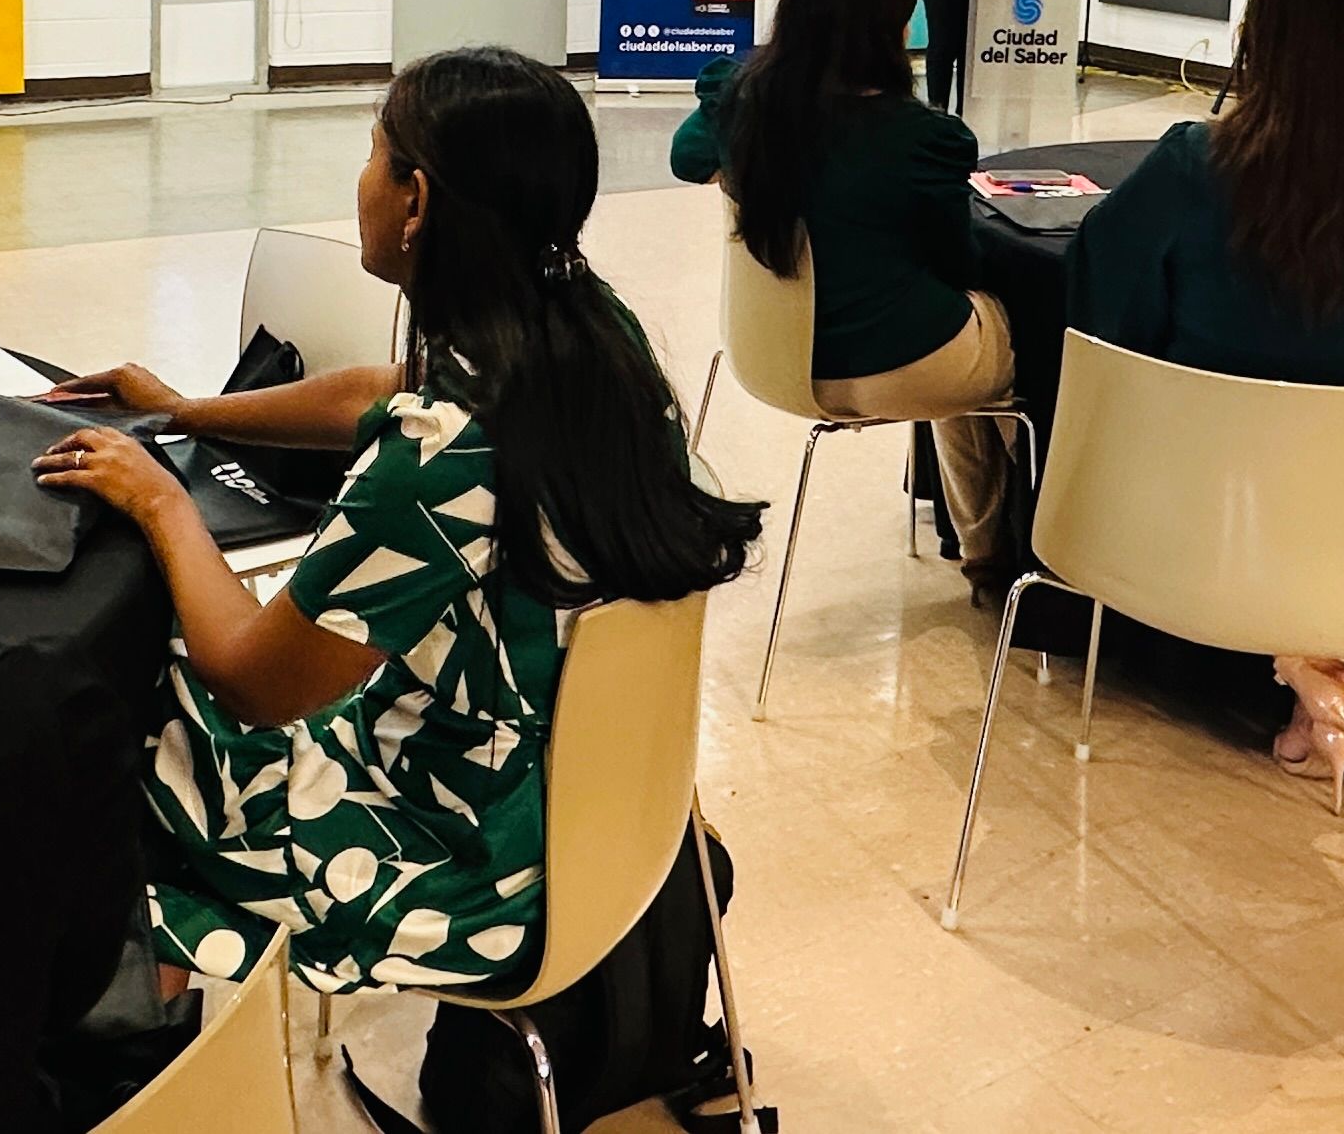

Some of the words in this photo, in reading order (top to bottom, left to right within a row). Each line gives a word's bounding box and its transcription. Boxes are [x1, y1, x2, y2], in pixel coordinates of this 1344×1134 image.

[993, 29, 1058, 46] Ciudad
[619, 40, 735, 54] ciudaddelsaber.org
[980, 47, 1009, 64] del
[1014, 48, 1068, 65] Saber
